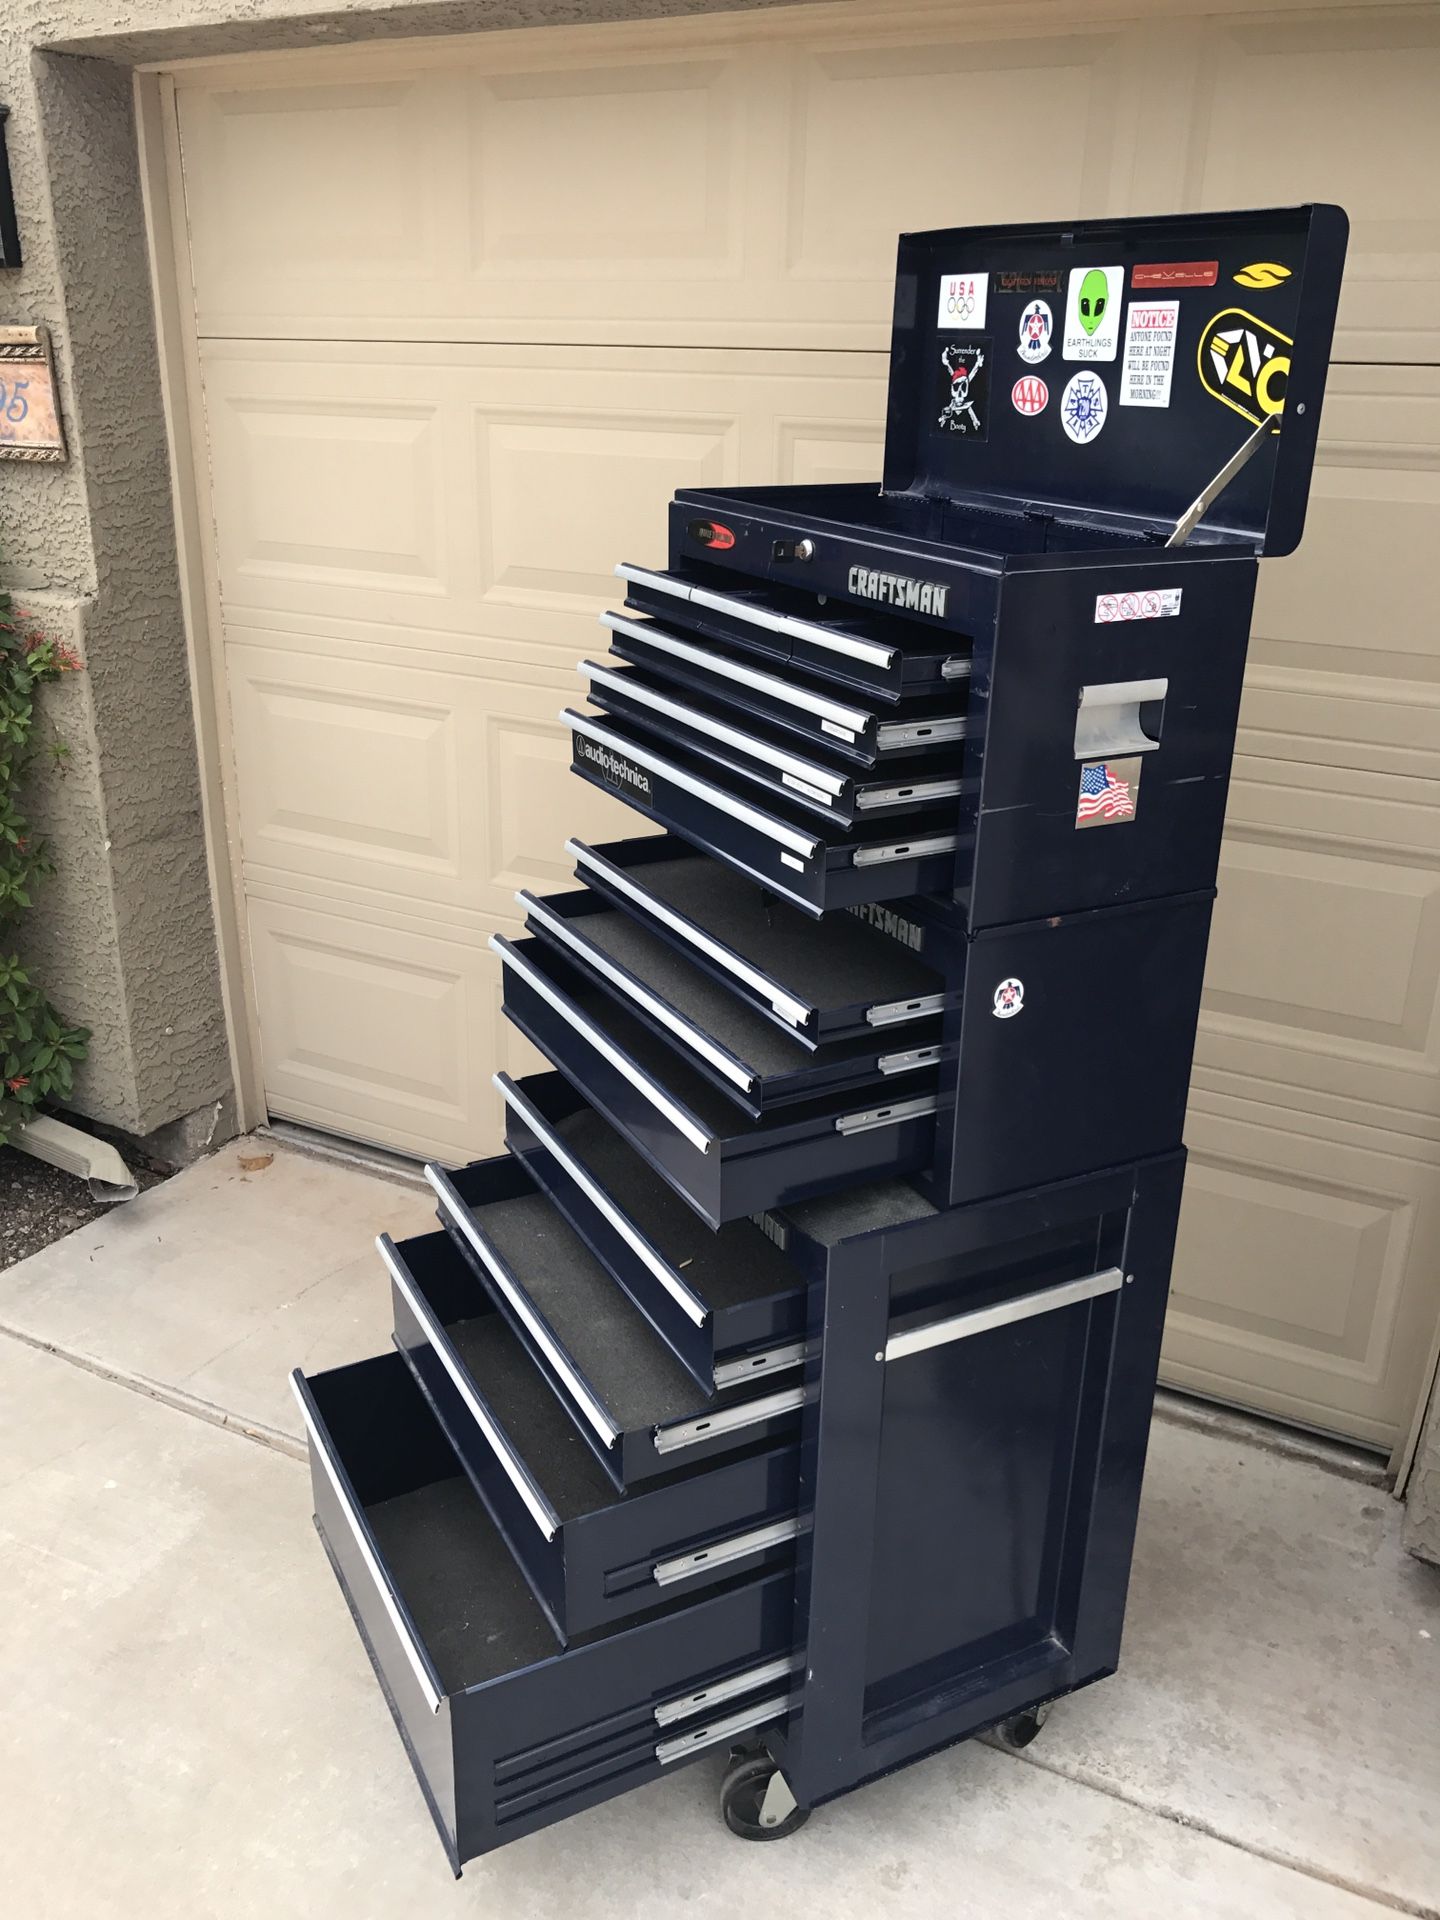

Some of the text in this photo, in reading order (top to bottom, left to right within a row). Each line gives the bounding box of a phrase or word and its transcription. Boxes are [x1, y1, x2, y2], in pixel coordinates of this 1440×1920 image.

[949, 281, 975, 296] USA
[1131, 310, 1175, 328] NOTICE
[1129, 331, 1172, 342] ANYONE FOUND
[1067, 338, 1112, 348] EARTHLINGS
[949, 344, 976, 356] Surrender
[1078, 349, 1098, 358] SUCK
[1128, 345, 1171, 356] HERE AT NIGHT
[1127, 360, 1170, 371] WILL BE FOUND
[1129, 374, 1145, 385] HERE
[1153, 374, 1165, 385] THE
[949, 419, 967, 433] Booty
[847, 565, 950, 618] CRAFTSMAN
